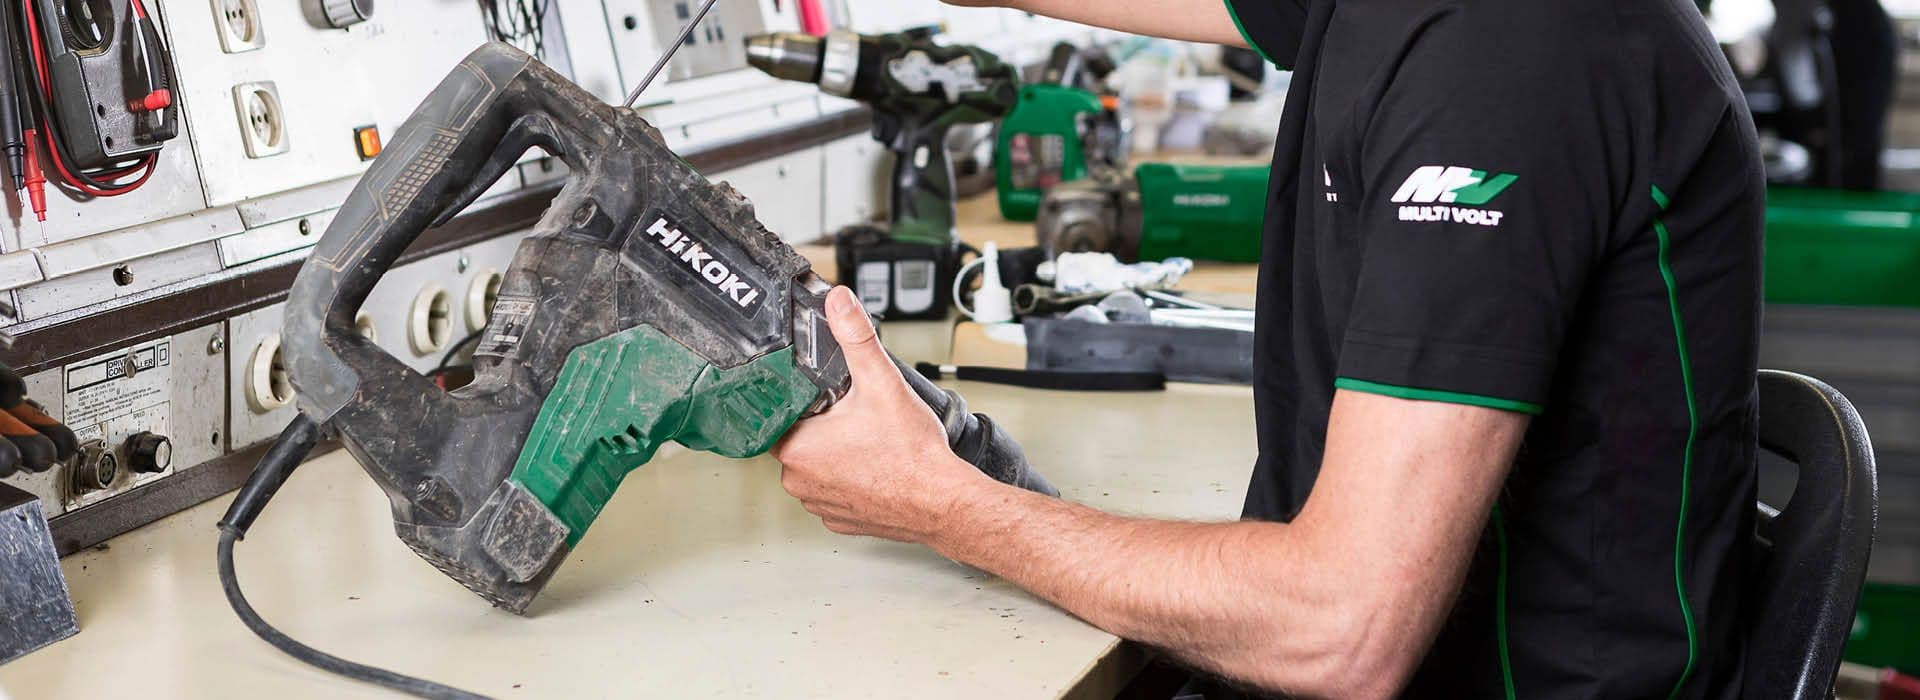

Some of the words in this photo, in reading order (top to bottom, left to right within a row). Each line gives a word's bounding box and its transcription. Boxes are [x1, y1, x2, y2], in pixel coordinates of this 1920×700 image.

[1398, 206, 1451, 221] MULTI
[1451, 207, 1504, 226] VOLT
[646, 217, 759, 308] HiKOKI
[108, 359, 126, 369] DRIV
